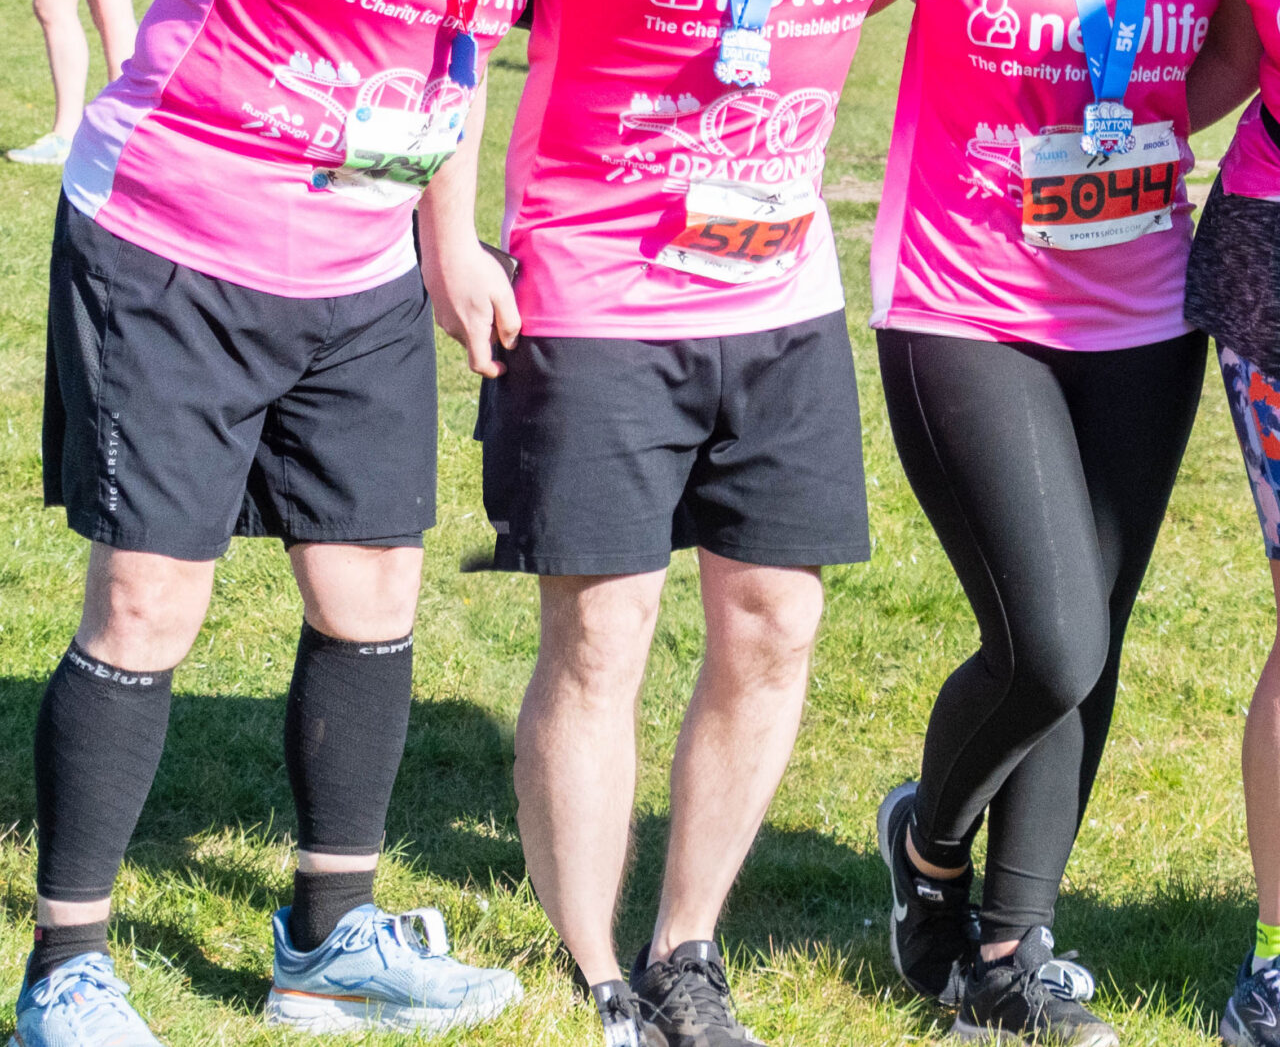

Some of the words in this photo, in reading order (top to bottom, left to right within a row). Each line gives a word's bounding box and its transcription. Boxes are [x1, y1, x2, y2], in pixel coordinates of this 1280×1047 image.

[420, 9, 443, 26] for
[644, 14, 678, 34] The
[777, 16, 840, 39] Disabled
[1115, 21, 1137, 52] 5K
[968, 54, 997, 74] The
[1000, 60, 1060, 84] Charity
[1064, 64, 1088, 83] for
[241, 102, 311, 142] RunThrough
[1087, 118, 1133, 133] DRAYTON
[1143, 139, 1170, 150] BROOKS
[601, 153, 666, 175] RunThrough
[1031, 163, 1174, 222] 5044
